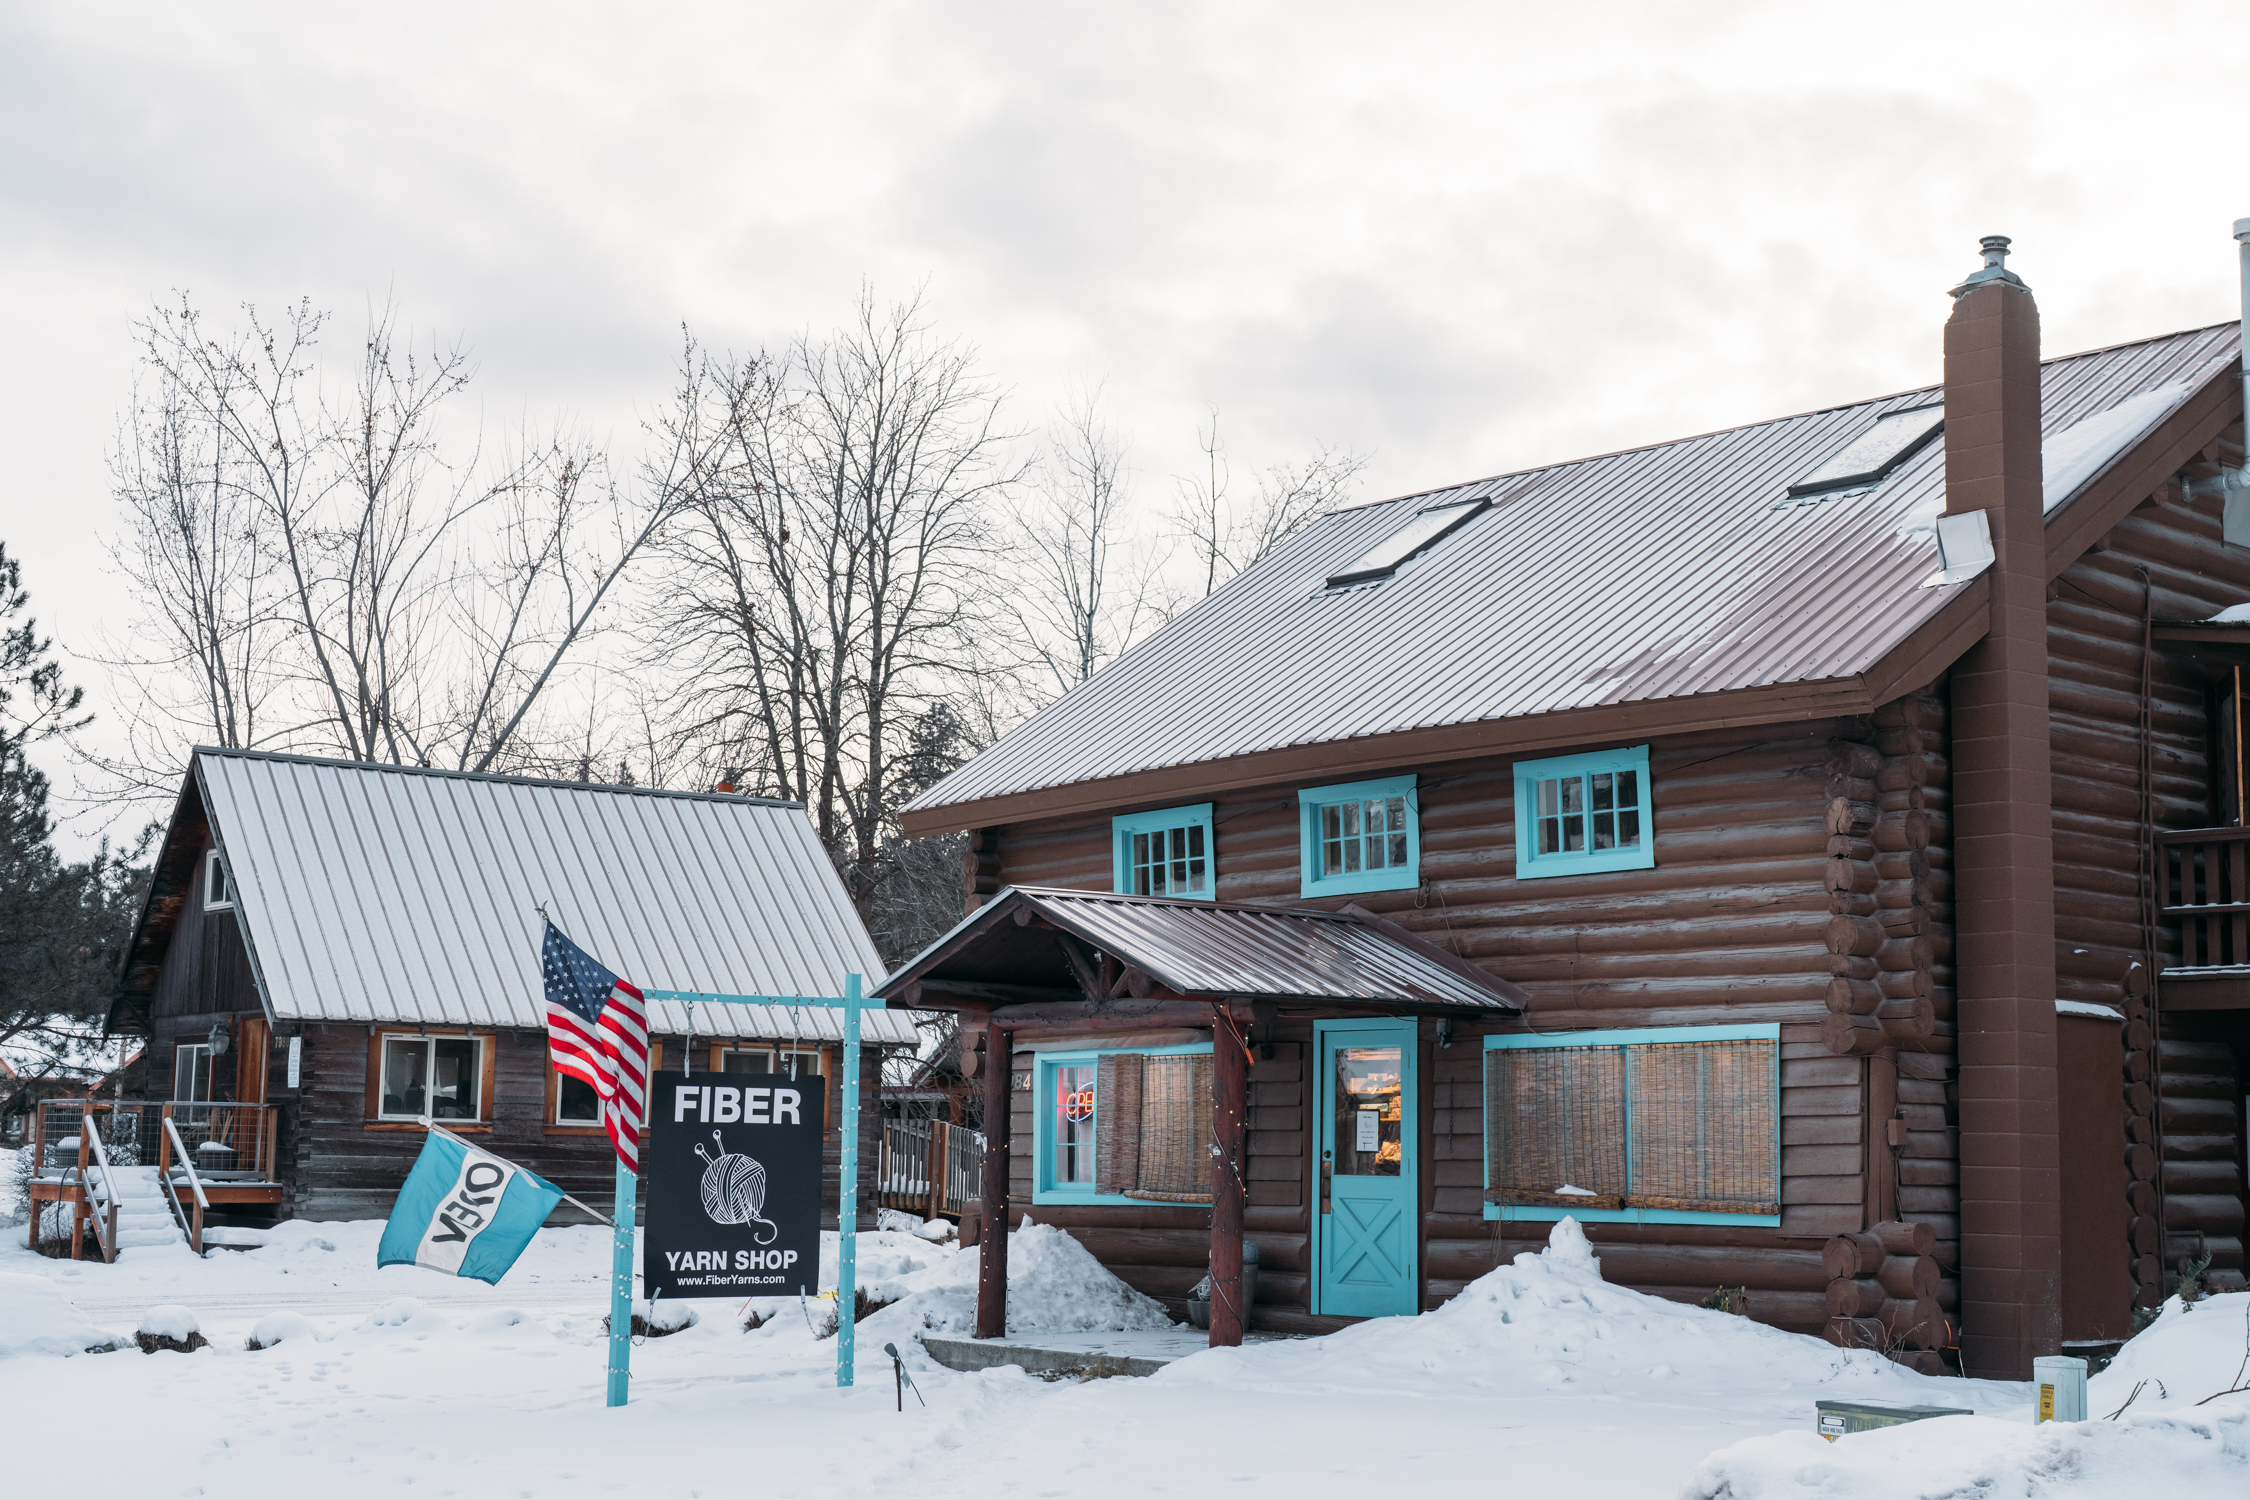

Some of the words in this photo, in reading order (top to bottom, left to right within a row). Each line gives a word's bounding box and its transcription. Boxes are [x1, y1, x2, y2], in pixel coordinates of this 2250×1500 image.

[1011, 1073, 1031, 1091] 84
[674, 1085, 801, 1125] FIBER
[1066, 1091, 1094, 1115] OPE
[665, 1251, 728, 1271] YARN
[734, 1249, 798, 1270] SHOP
[677, 1274, 785, 1286] www.FiberYarns.com
